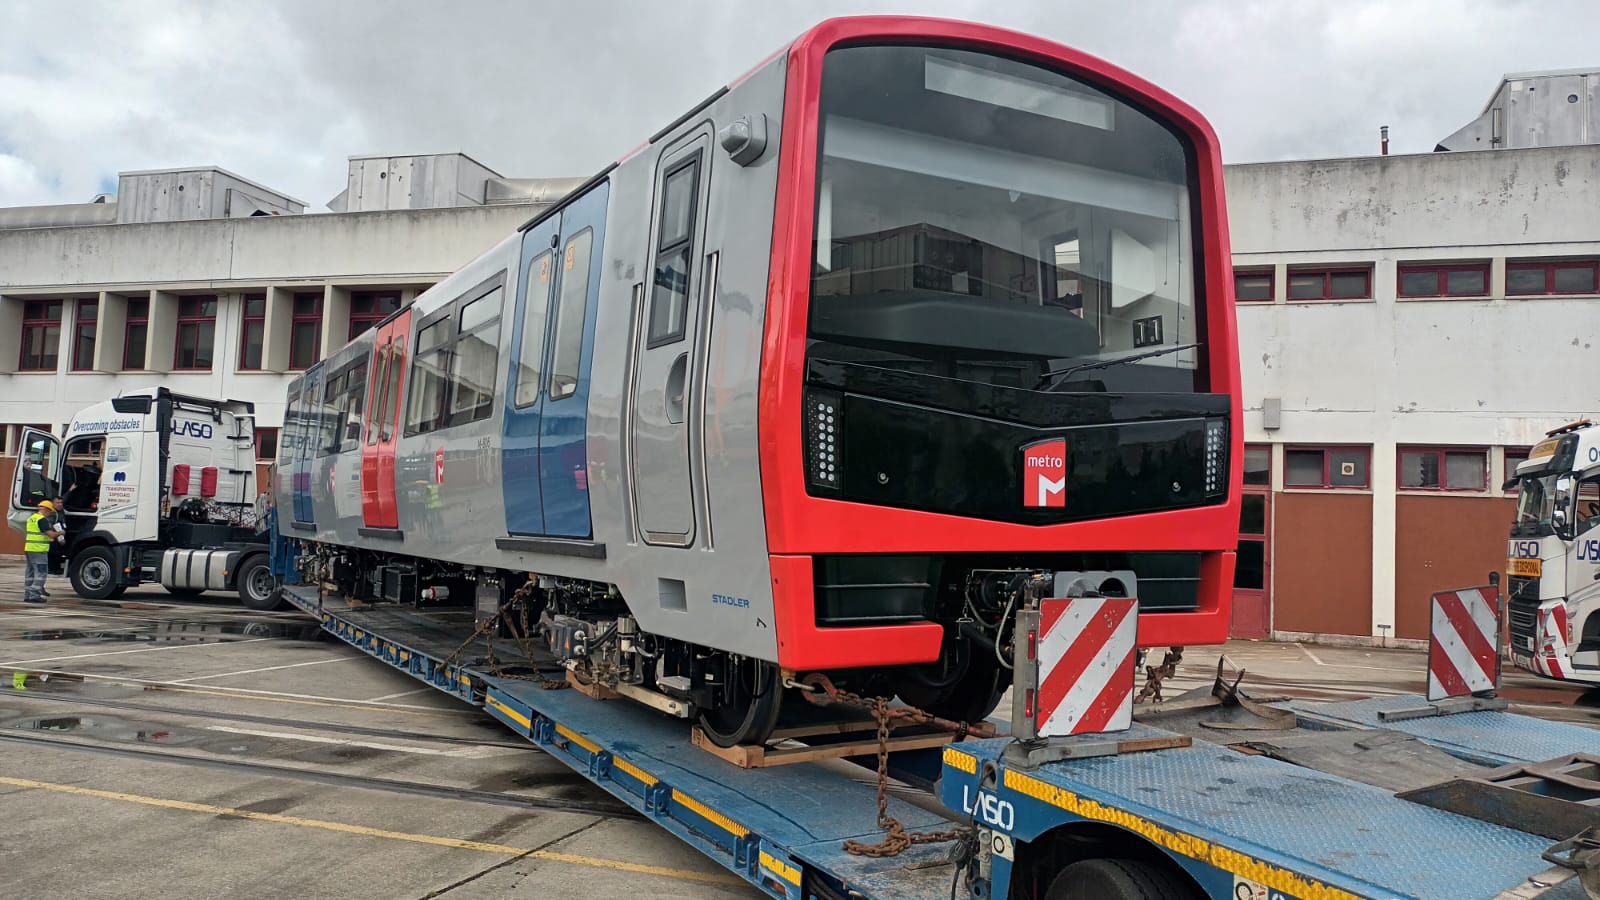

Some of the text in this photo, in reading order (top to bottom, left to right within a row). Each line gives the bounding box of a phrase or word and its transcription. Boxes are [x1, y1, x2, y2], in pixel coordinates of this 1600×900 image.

[73, 418, 140, 431] Overcoming obstacles
[173, 419, 213, 439] LASO
[1028, 454, 1062, 468] metro
[1508, 541, 1539, 558] LASO
[1577, 540, 1600, 560] LAS
[712, 594, 750, 608] STADLER
[963, 784, 1014, 831] LASO
